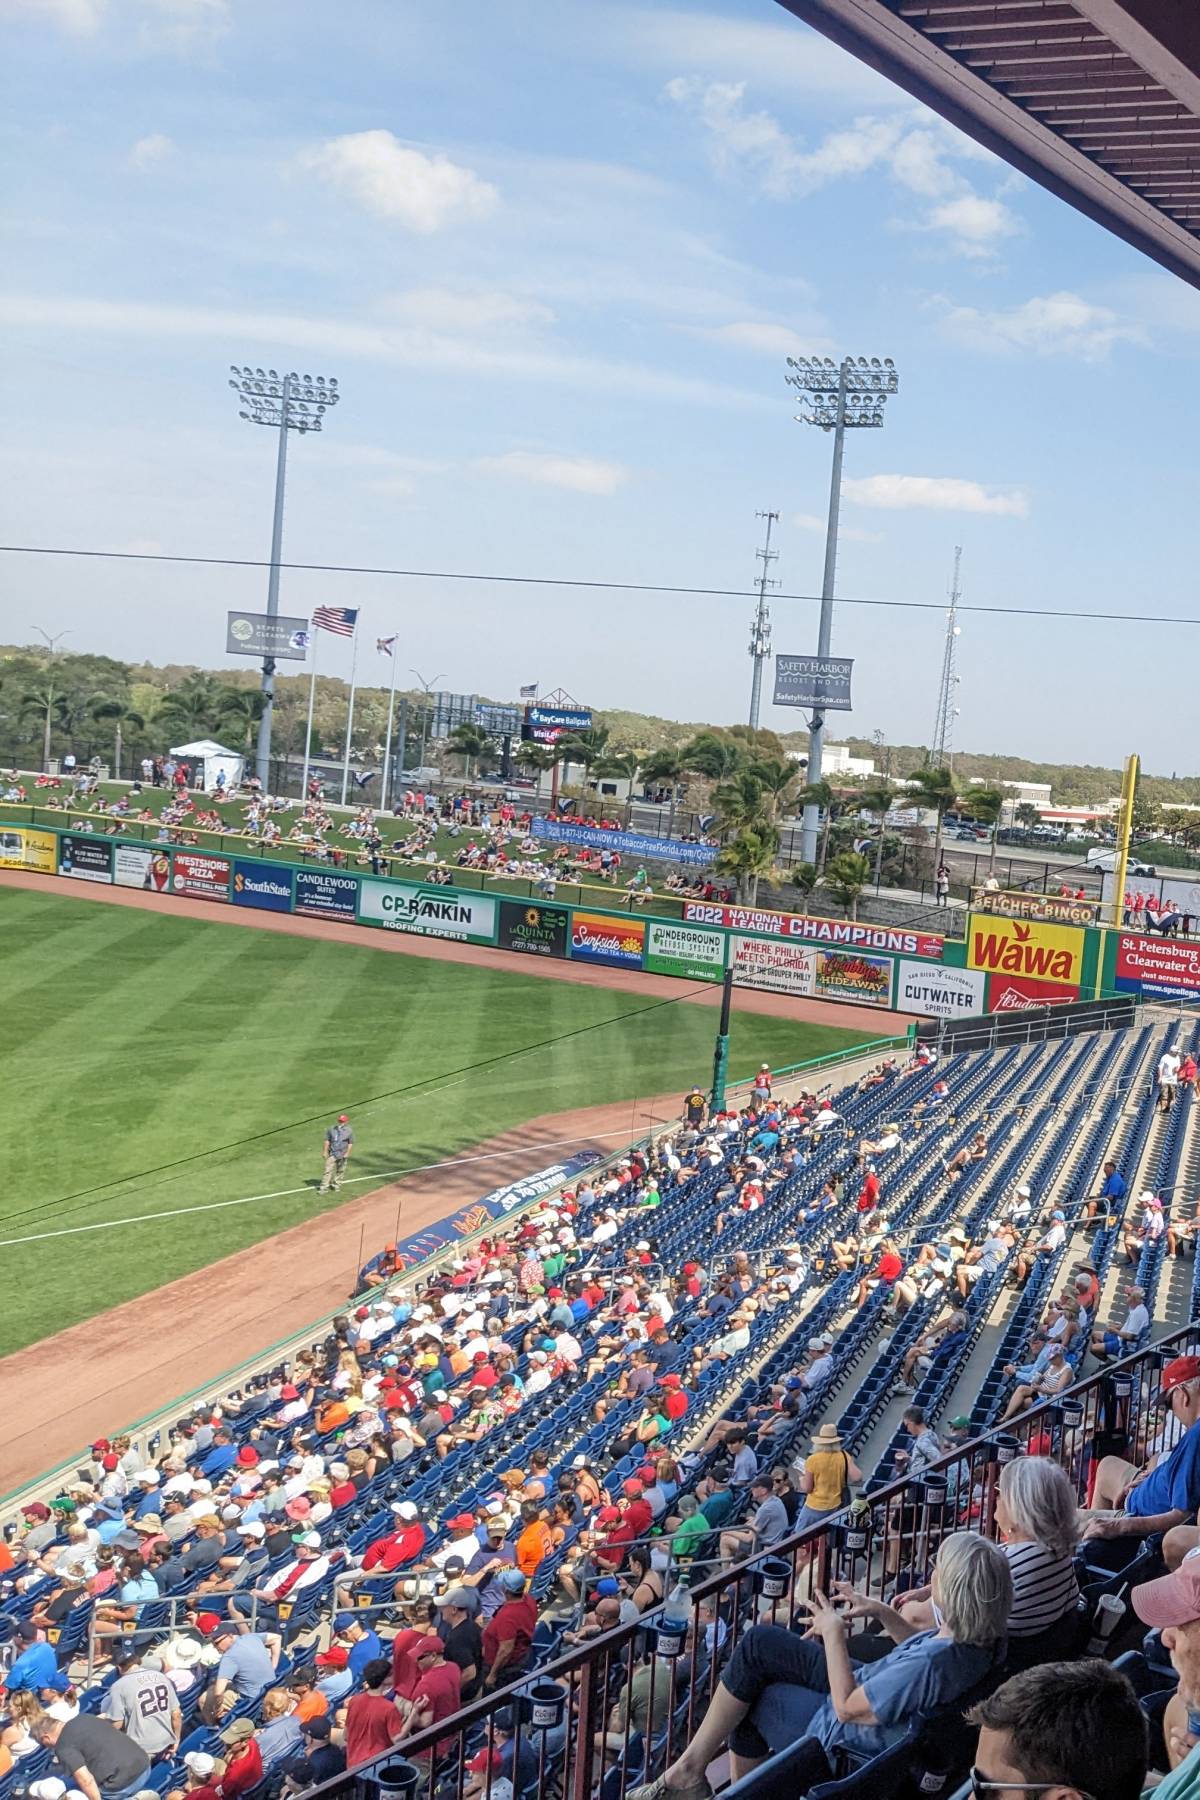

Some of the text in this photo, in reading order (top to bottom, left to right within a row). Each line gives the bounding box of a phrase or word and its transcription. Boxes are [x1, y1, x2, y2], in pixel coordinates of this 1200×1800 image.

[778, 659, 850, 674] SAFETY HARBOR
[540, 714, 592, 727] BayCare Ballpark
[176, 855, 229, 872] WESTSHORE
[189, 867, 214, 879] PIZZA
[296, 873, 357, 890] CANDLEWOOD
[244, 878, 291, 897] SouthState
[316, 885, 336, 895] SUITES
[686, 904, 723, 925] 2022
[974, 895, 1092, 921] BELCHER BINGO
[728, 909, 785, 926] NATIONAL
[731, 918, 782, 934] LEAGUE
[383, 920, 468, 940] ROOFING EXPERTS
[572, 925, 621, 951] Surfside
[657, 928, 721, 946] UNDERGROUND
[788, 919, 918, 953] CHAMPIONS
[660, 939, 720, 955] REFUSE SYSTEMS
[743, 942, 804, 959] WHERE PHILLY
[974, 932, 1073, 980] Wawa
[1122, 938, 1137, 951] St.
[1139, 940, 1199, 962] Petersburg
[736, 951, 810, 971] MEETS PHLORIDA
[1126, 953, 1187, 972] Clearwater
[767, 968, 793, 979] GROUPER
[793, 970, 811, 982] PHILLY
[821, 975, 884, 993] HIDEAWAY
[1140, 971, 1156, 980] Just
[1158, 974, 1182, 983] across
[1183, 977, 1195, 985] the
[905, 985, 973, 1008] CUTWATER
[924, 1003, 952, 1015] SPIRITS
[138, 1685, 168, 1718] 28
